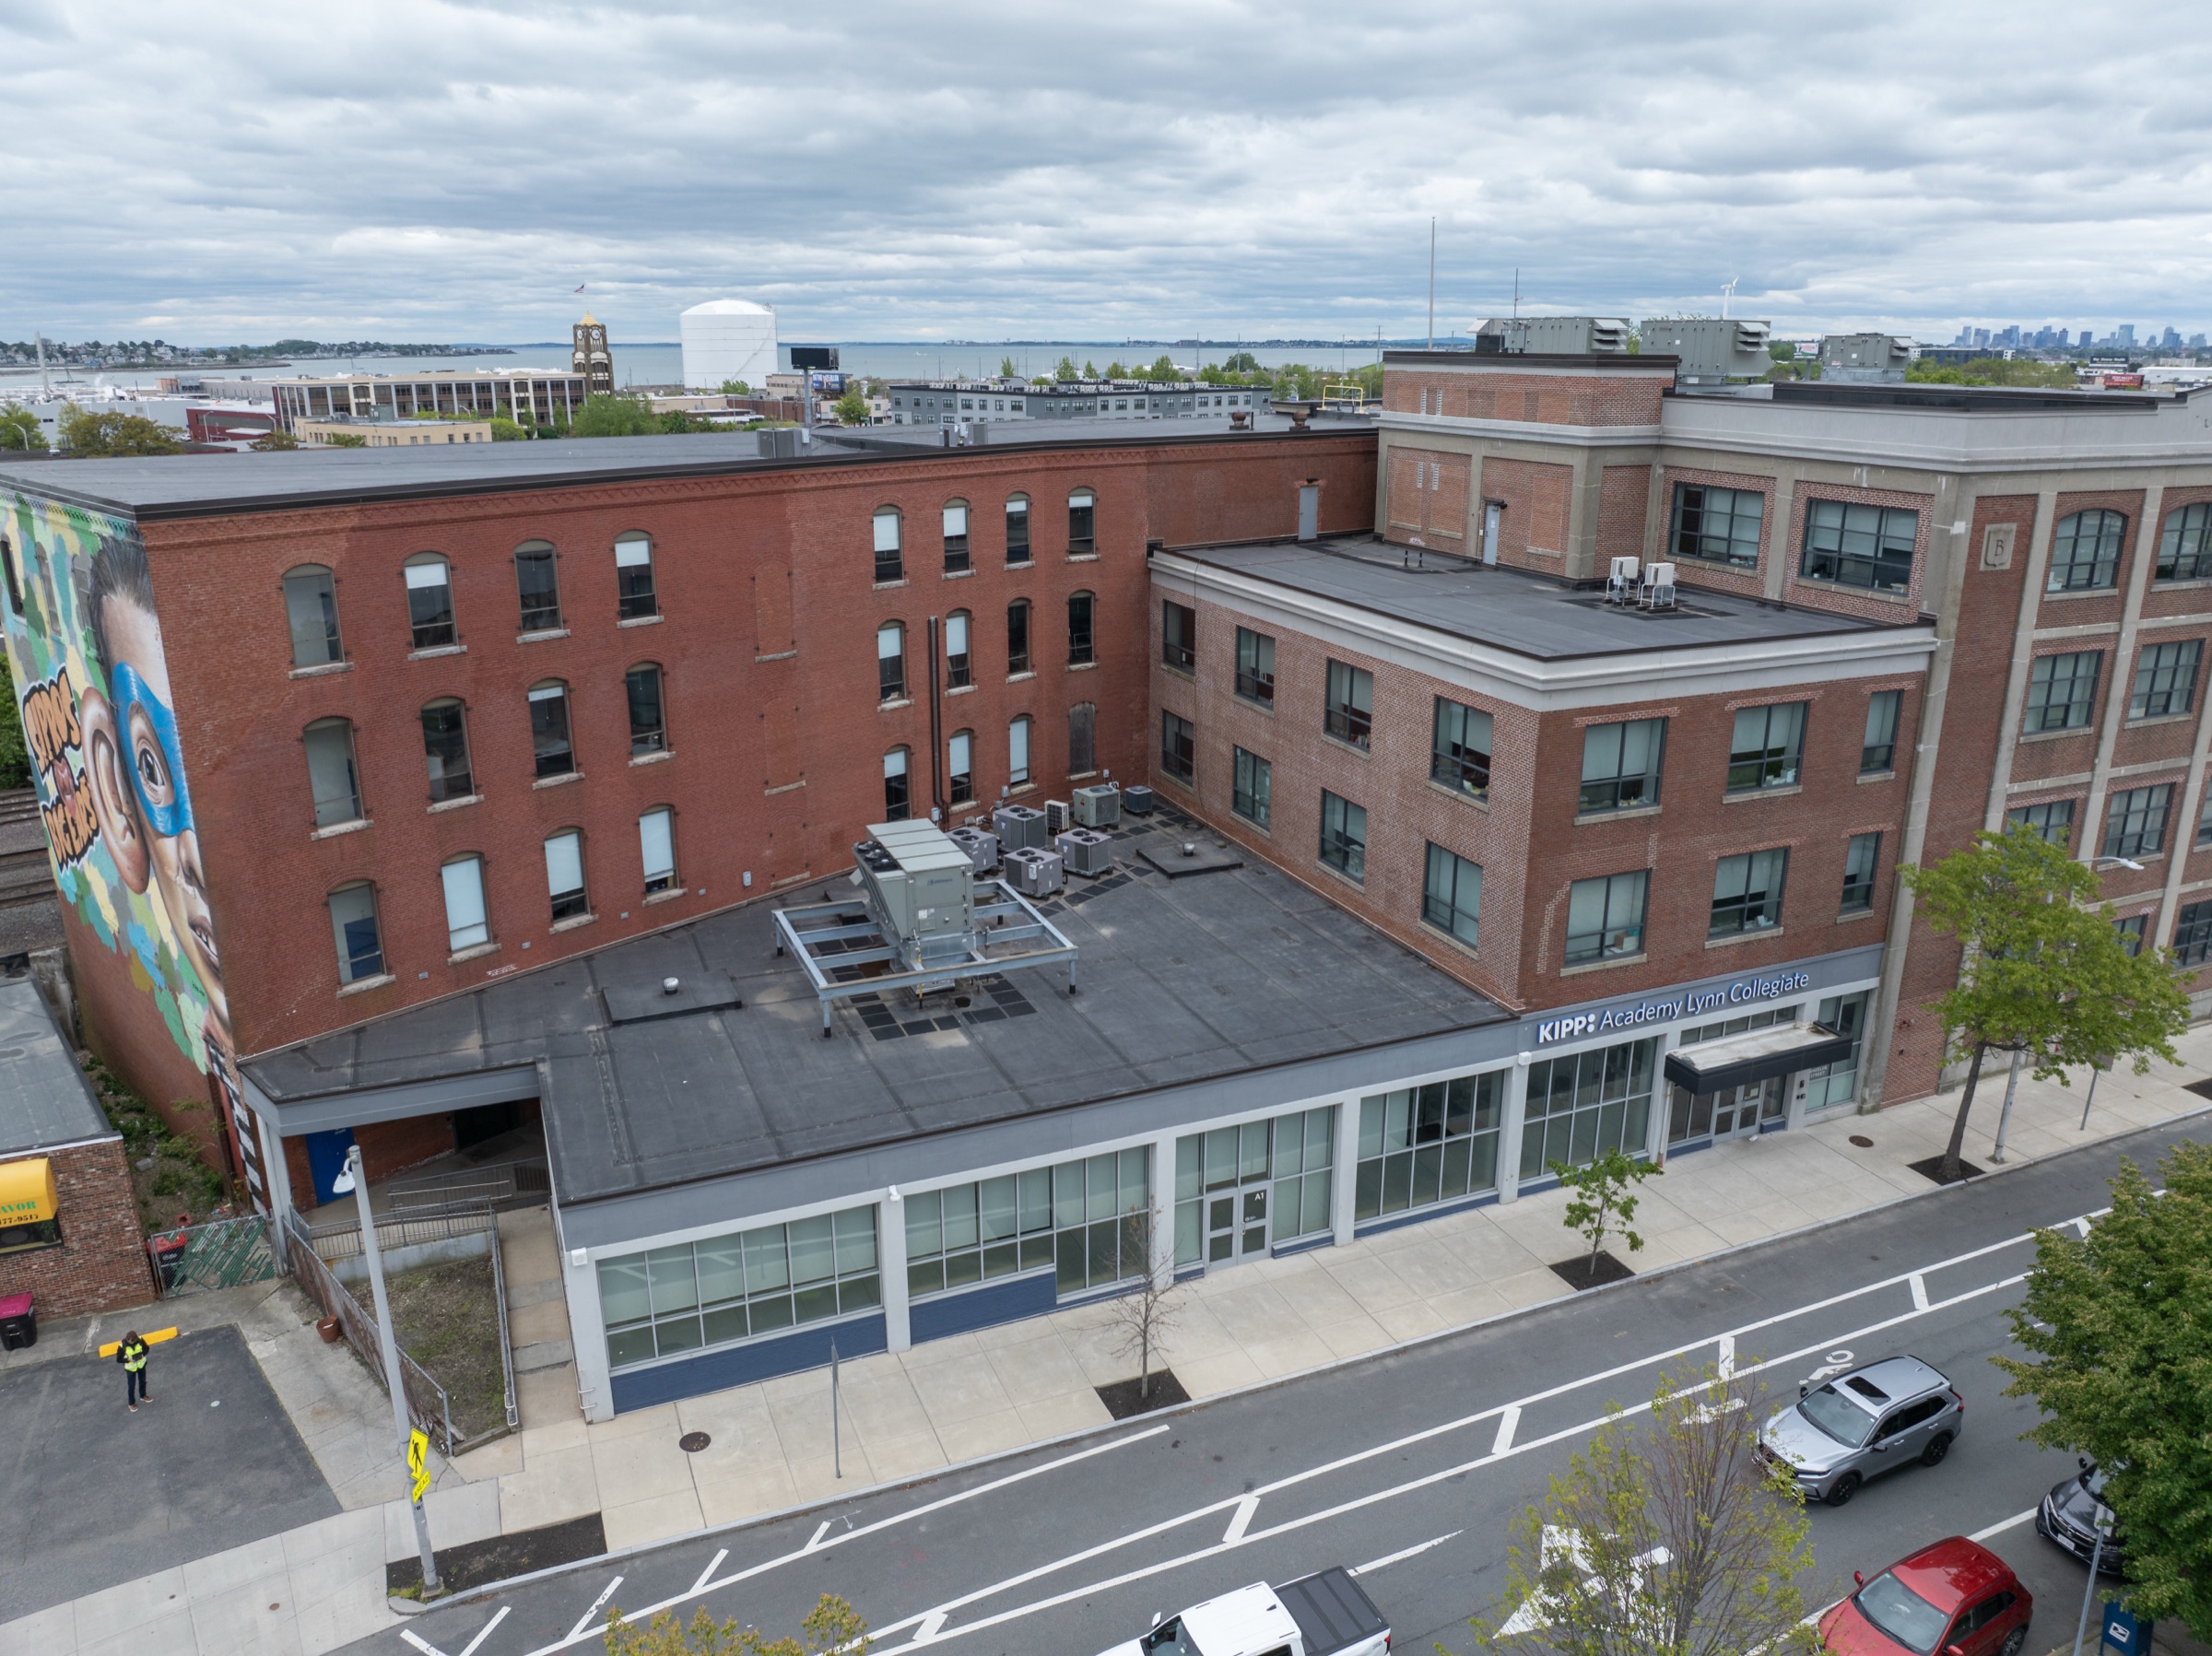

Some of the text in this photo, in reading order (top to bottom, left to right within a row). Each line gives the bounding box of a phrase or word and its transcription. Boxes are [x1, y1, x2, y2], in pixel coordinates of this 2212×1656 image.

[1994, 539, 2005, 557] B
[42, 799, 74, 867] BIG
[1598, 1001, 1682, 1030] Academy
[1687, 992, 1725, 1015] Lynn
[1729, 971, 1809, 1004] Collegiate
[1254, 1192, 1264, 1201] A1
